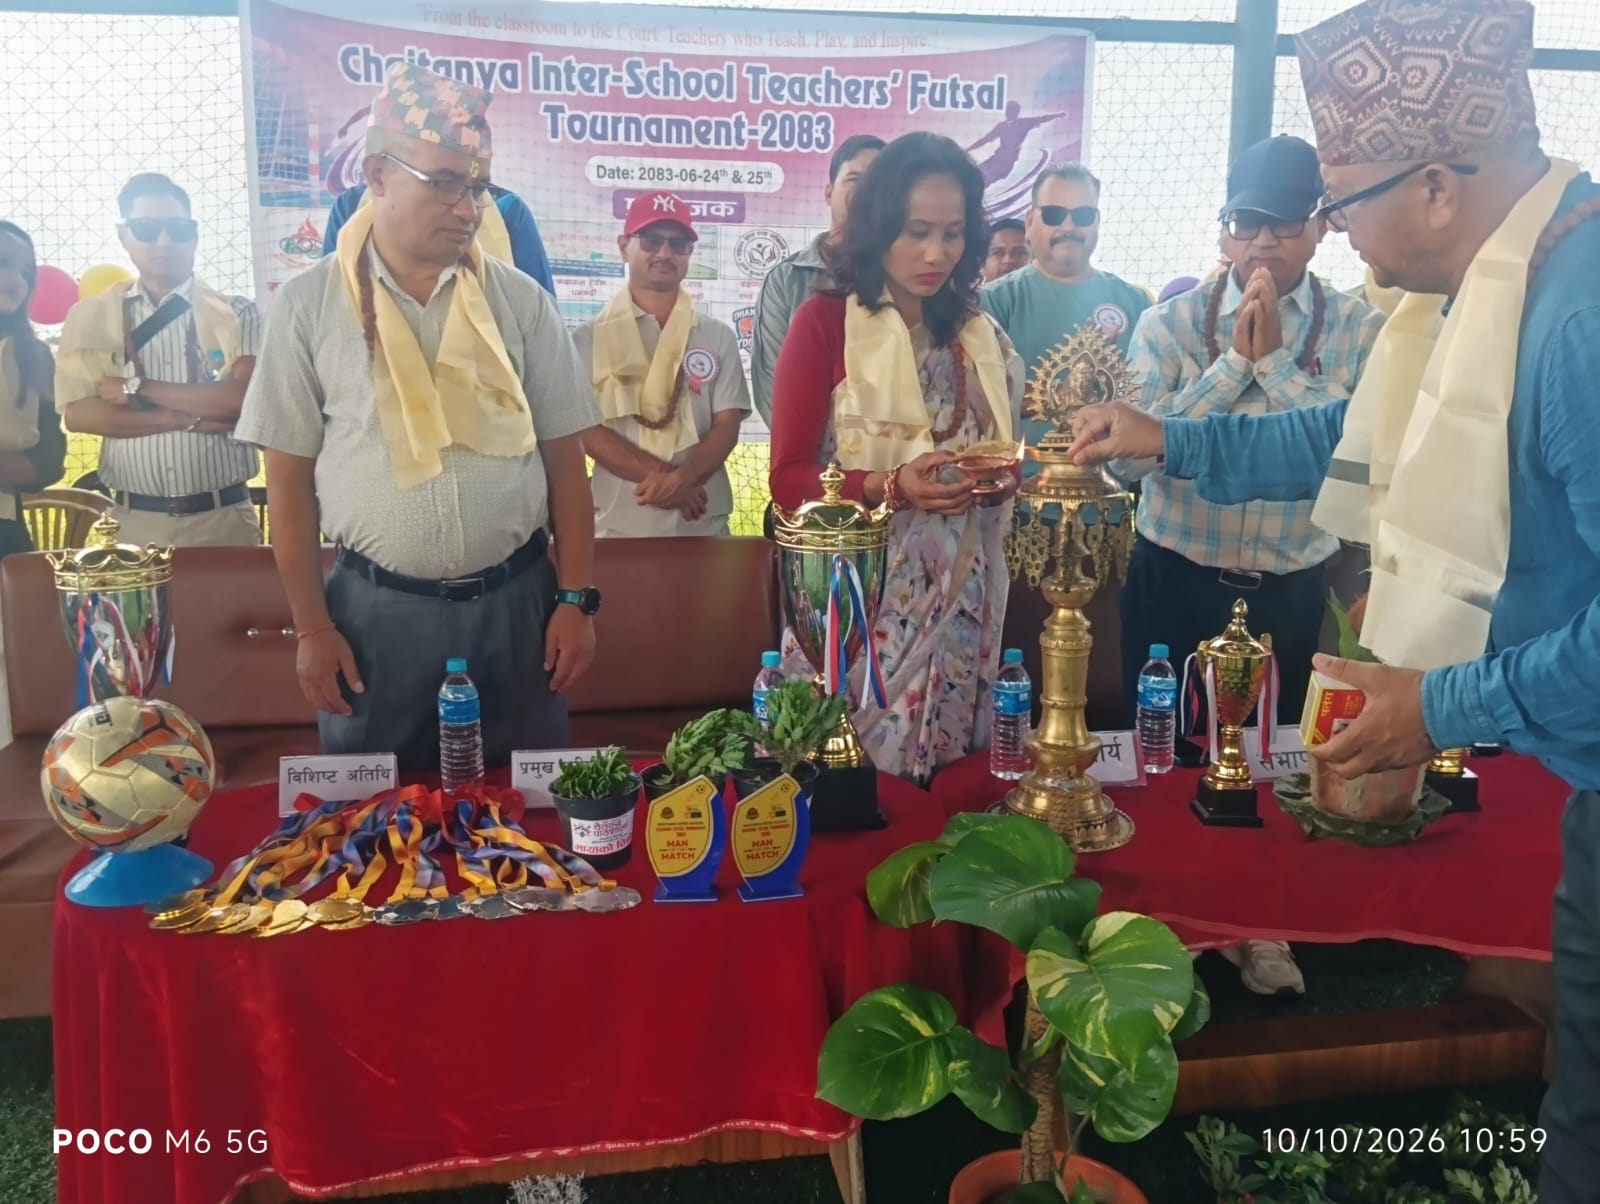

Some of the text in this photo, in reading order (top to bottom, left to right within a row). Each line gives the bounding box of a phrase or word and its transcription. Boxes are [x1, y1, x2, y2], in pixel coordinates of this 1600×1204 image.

[467, 10, 490, 28] the
[495, 12, 568, 36] classroom
[572, 21, 586, 36] to
[591, 21, 612, 39] the
[667, 26, 727, 46] Teachers
[732, 28, 762, 46] who
[852, 30, 876, 48] and
[530, 54, 735, 100] Inter-School
[909, 72, 1006, 112] Futsal
[543, 104, 832, 150] Tournament-2083
[596, 164, 772, 185] Date: 2083-06-24th & 25th
[287, 764, 393, 785] विशिष्ट अतिथि
[520, 761, 555, 779] प्रमुख
[666, 839, 688, 848] MAN
[752, 839, 773, 848] MAN
[661, 851, 695, 860] MATCH
[746, 850, 779, 860] MATCH
